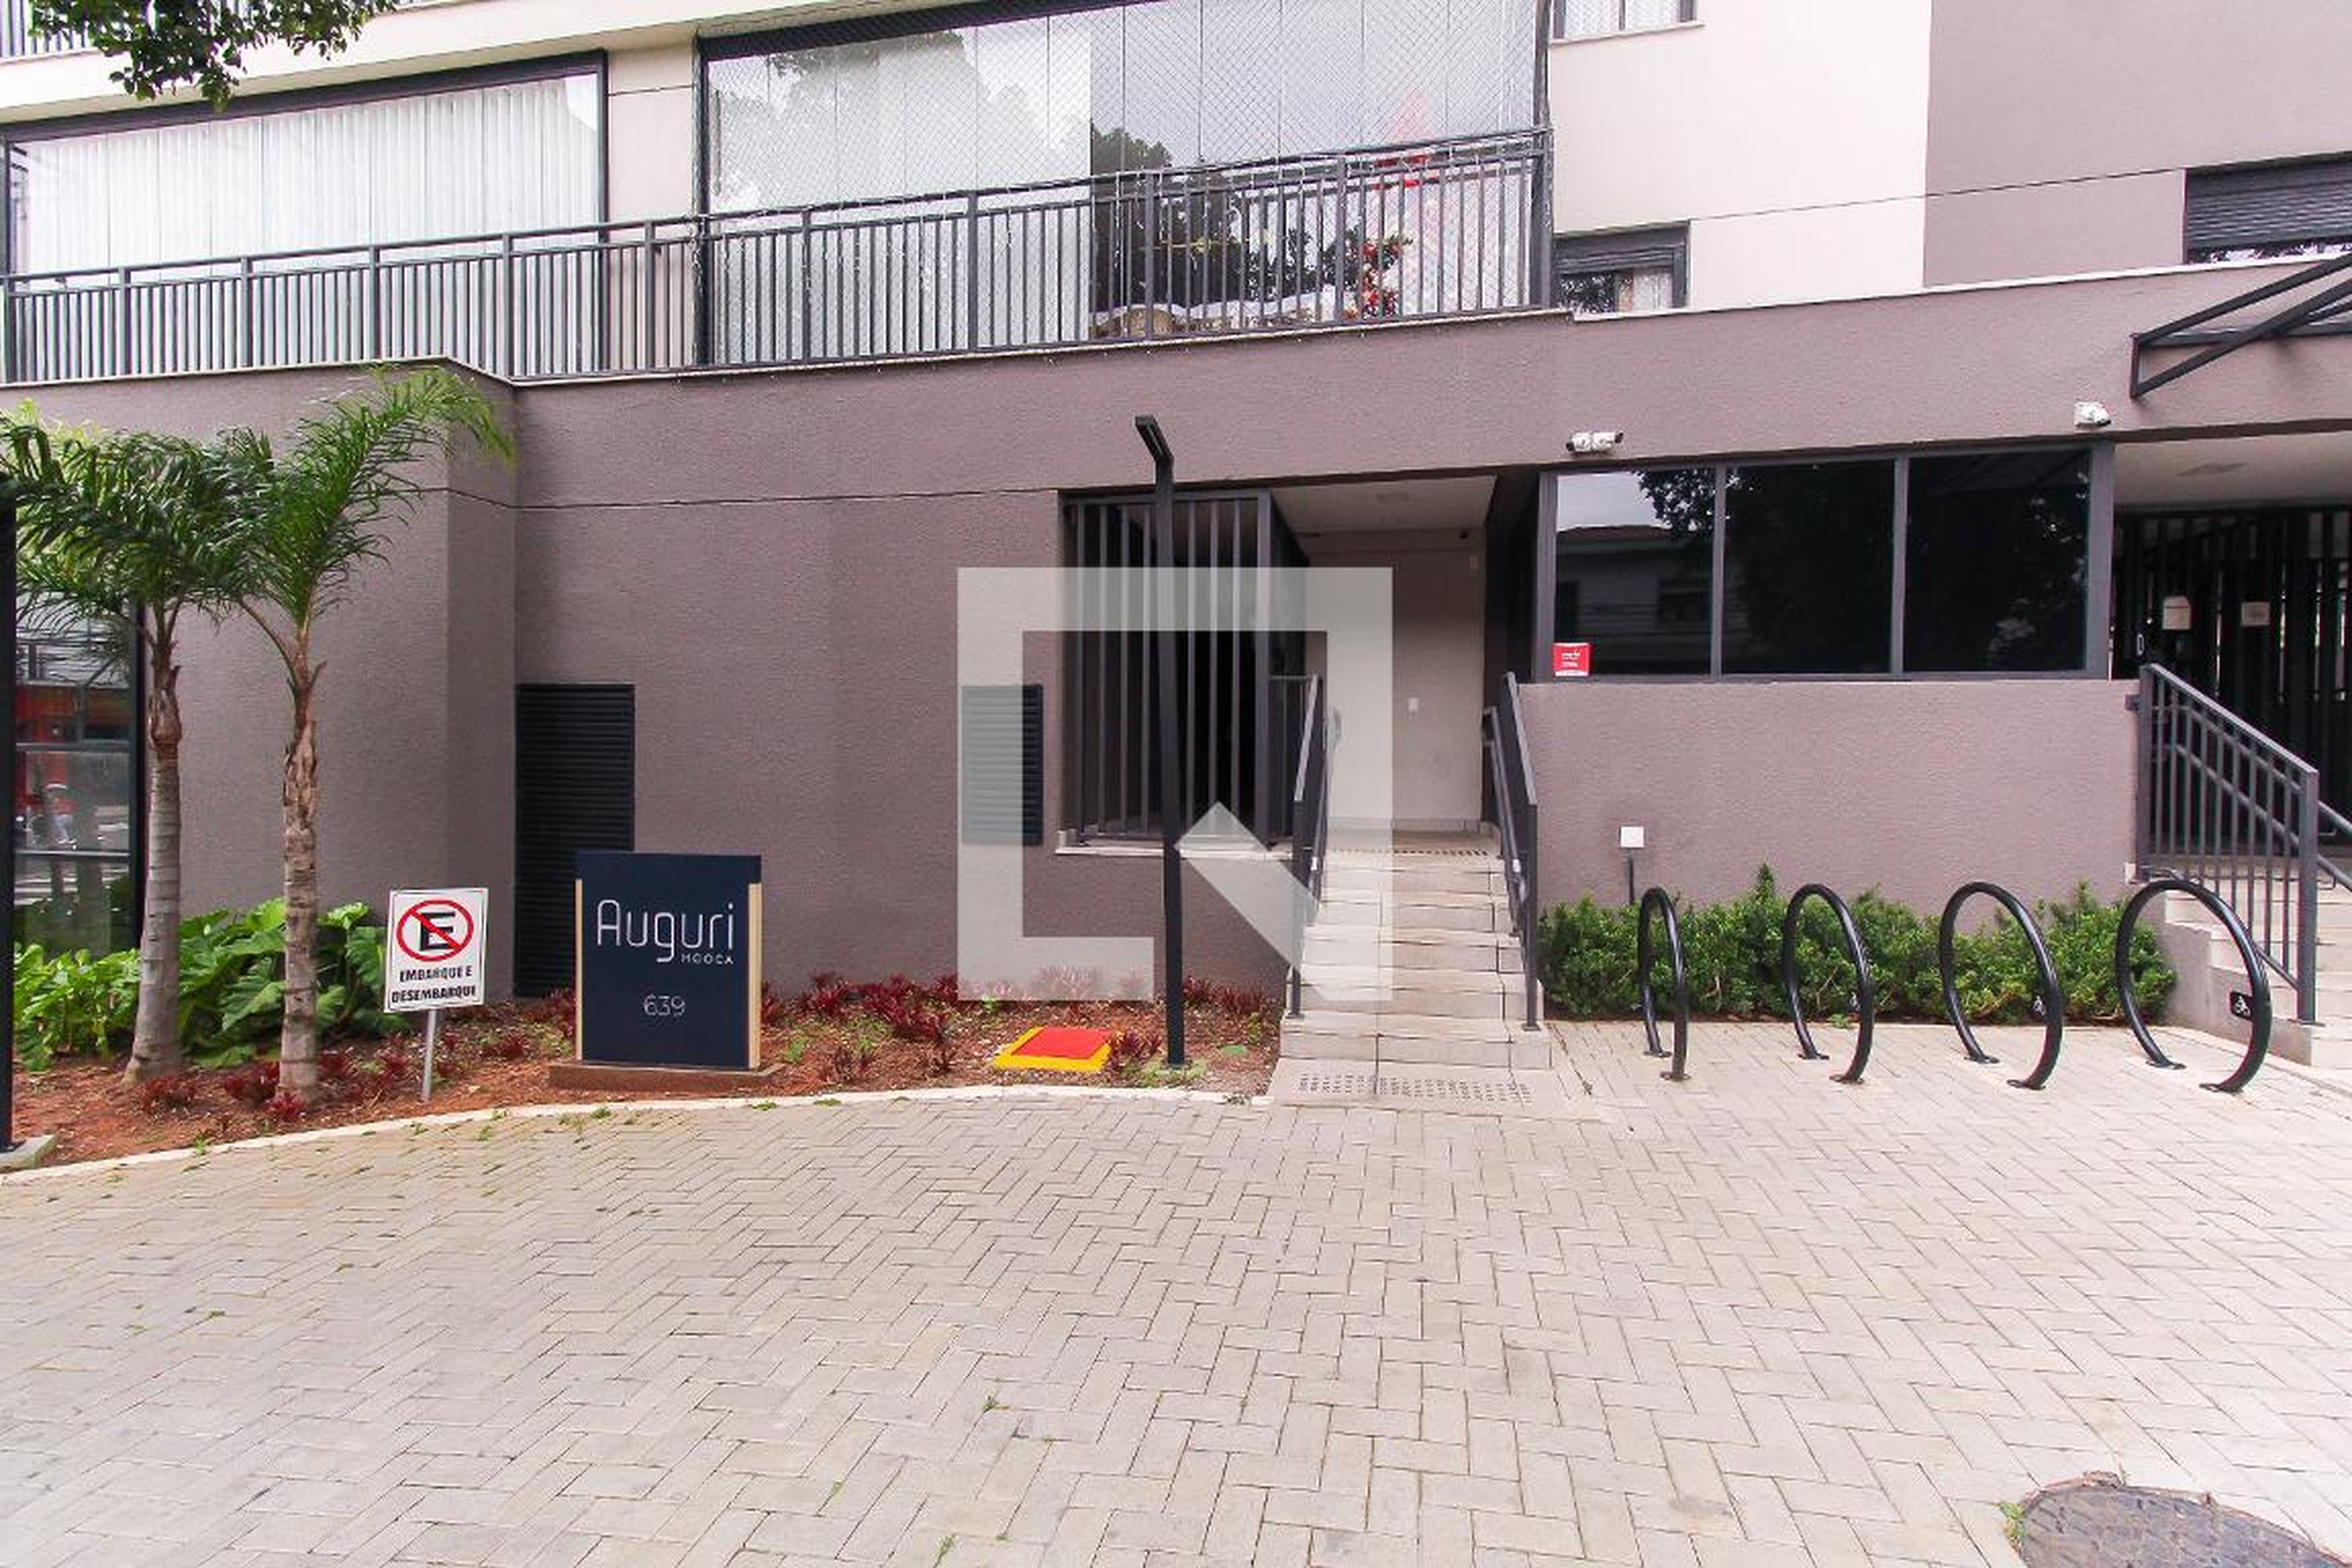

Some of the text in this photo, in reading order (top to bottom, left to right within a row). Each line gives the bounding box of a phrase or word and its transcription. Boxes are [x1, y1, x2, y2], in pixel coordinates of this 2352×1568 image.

[597, 899, 733, 962] Auguri
[681, 953, 734, 964] MOOCA
[399, 965, 472, 982] EMBARQUE E
[391, 986, 476, 1003] DESEMBARQUE
[644, 994, 685, 1016] 639
